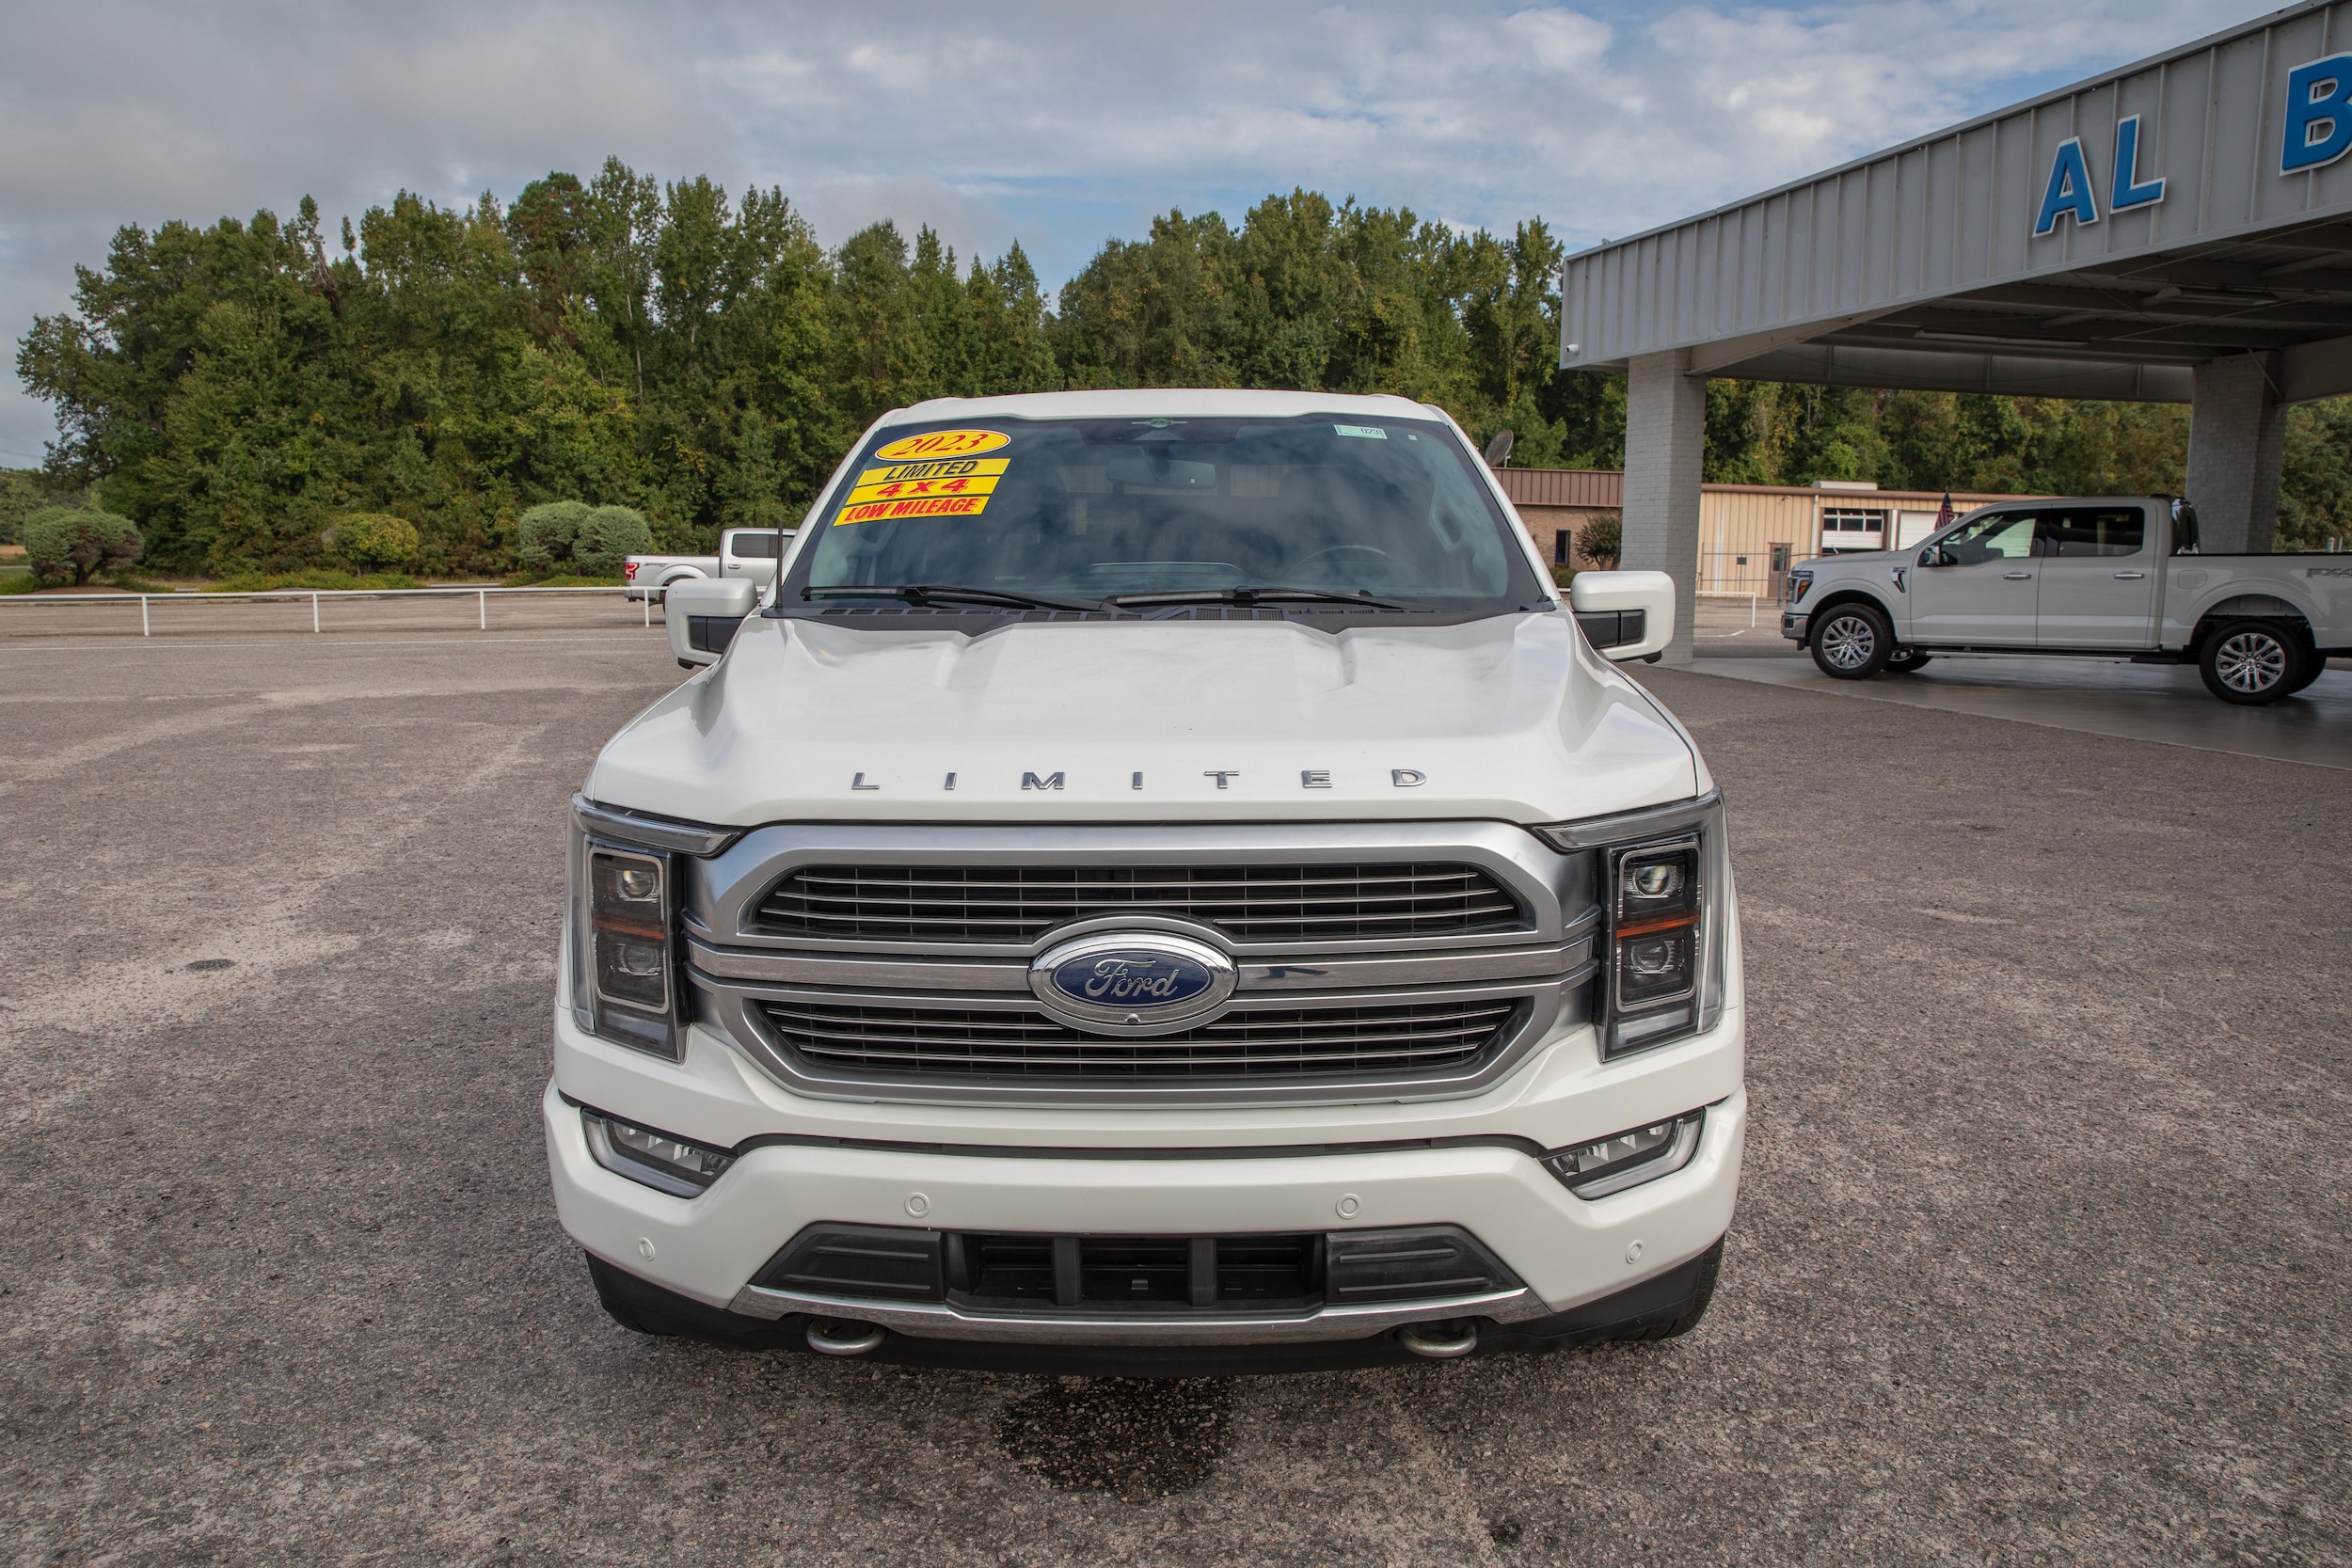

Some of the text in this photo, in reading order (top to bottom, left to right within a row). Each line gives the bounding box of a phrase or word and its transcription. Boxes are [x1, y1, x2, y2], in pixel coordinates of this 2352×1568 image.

[2032, 51, 2352, 238] AL B
[1360, 427, 1379, 436] 023
[890, 433, 989, 457] 2023
[882, 460, 979, 482] LIMITED
[843, 498, 982, 522] LOW MILEAGE
[851, 768, 1427, 790] LIMITED
[1084, 958, 1180, 997] Ford
